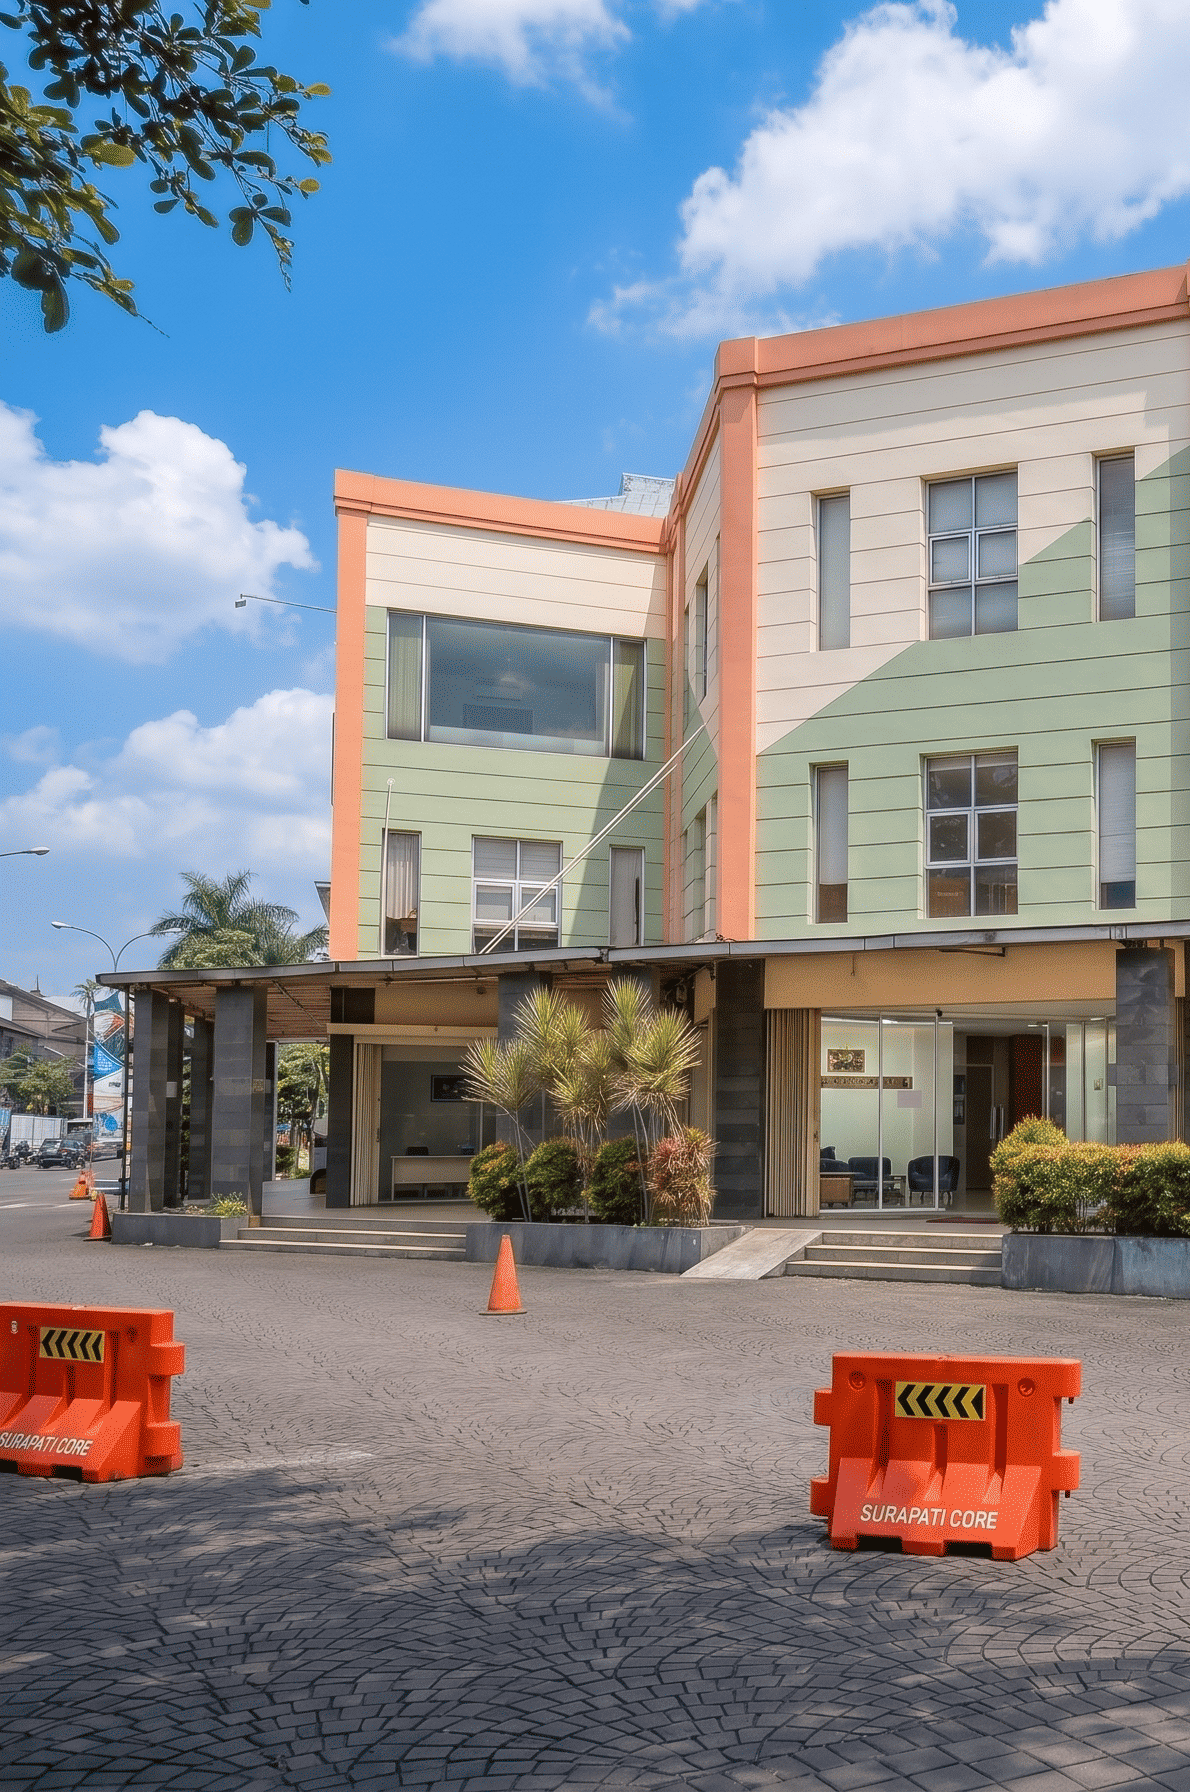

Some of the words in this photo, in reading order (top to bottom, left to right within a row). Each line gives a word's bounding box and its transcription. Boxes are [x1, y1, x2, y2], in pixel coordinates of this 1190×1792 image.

[0, 1432, 59, 1453] SURAPATI
[55, 1437, 93, 1456] CORE
[860, 1504, 947, 1526] SURAPATI
[949, 1509, 999, 1530] CORE
